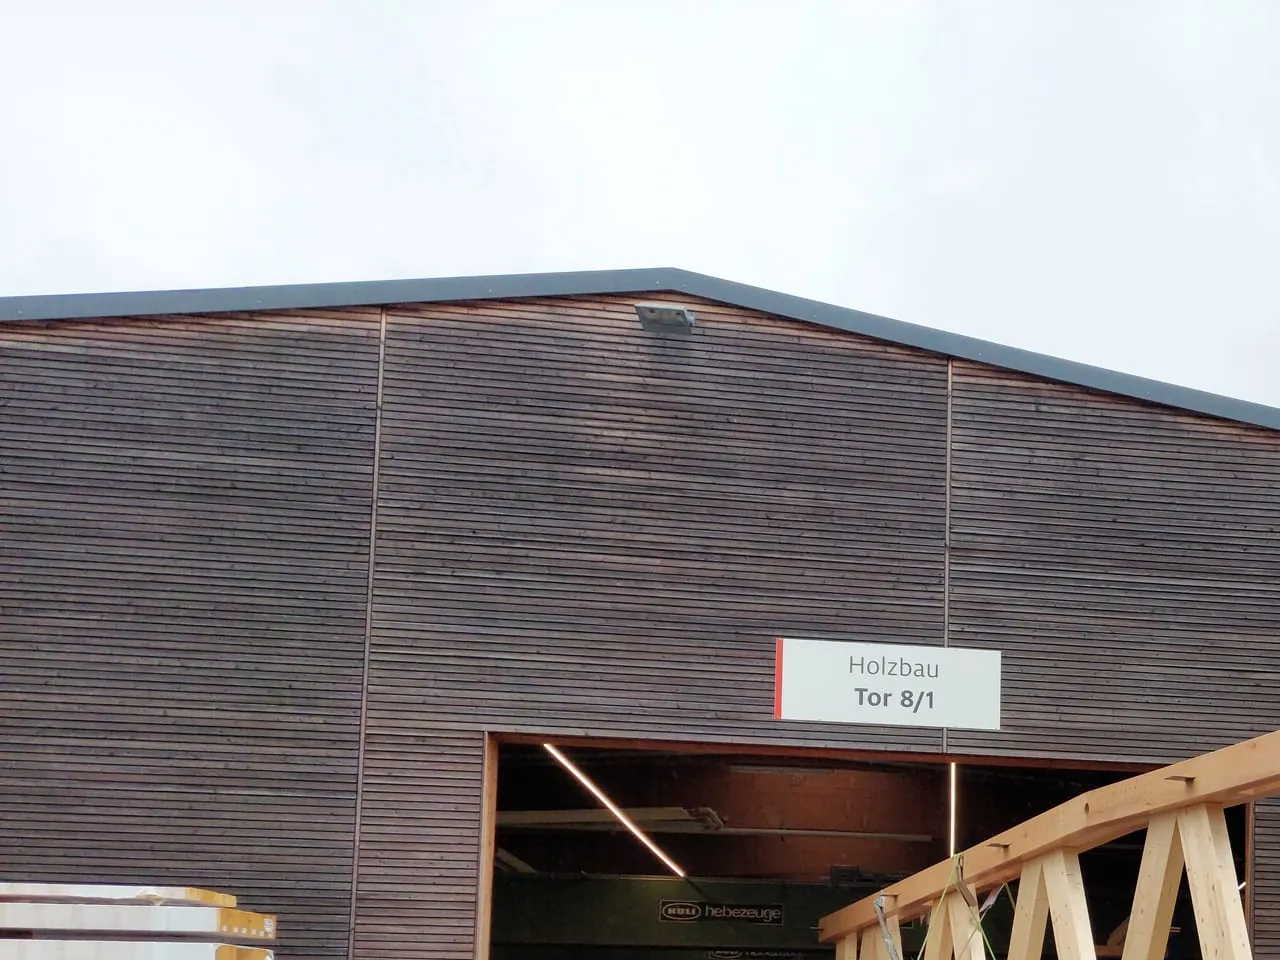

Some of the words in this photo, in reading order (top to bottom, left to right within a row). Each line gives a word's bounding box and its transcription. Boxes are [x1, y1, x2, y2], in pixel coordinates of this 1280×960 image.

[849, 655, 939, 679] Holzbau
[854, 687, 892, 708] Tor
[900, 690, 934, 714] 8/1
[705, 904, 781, 921] hebezeuge
